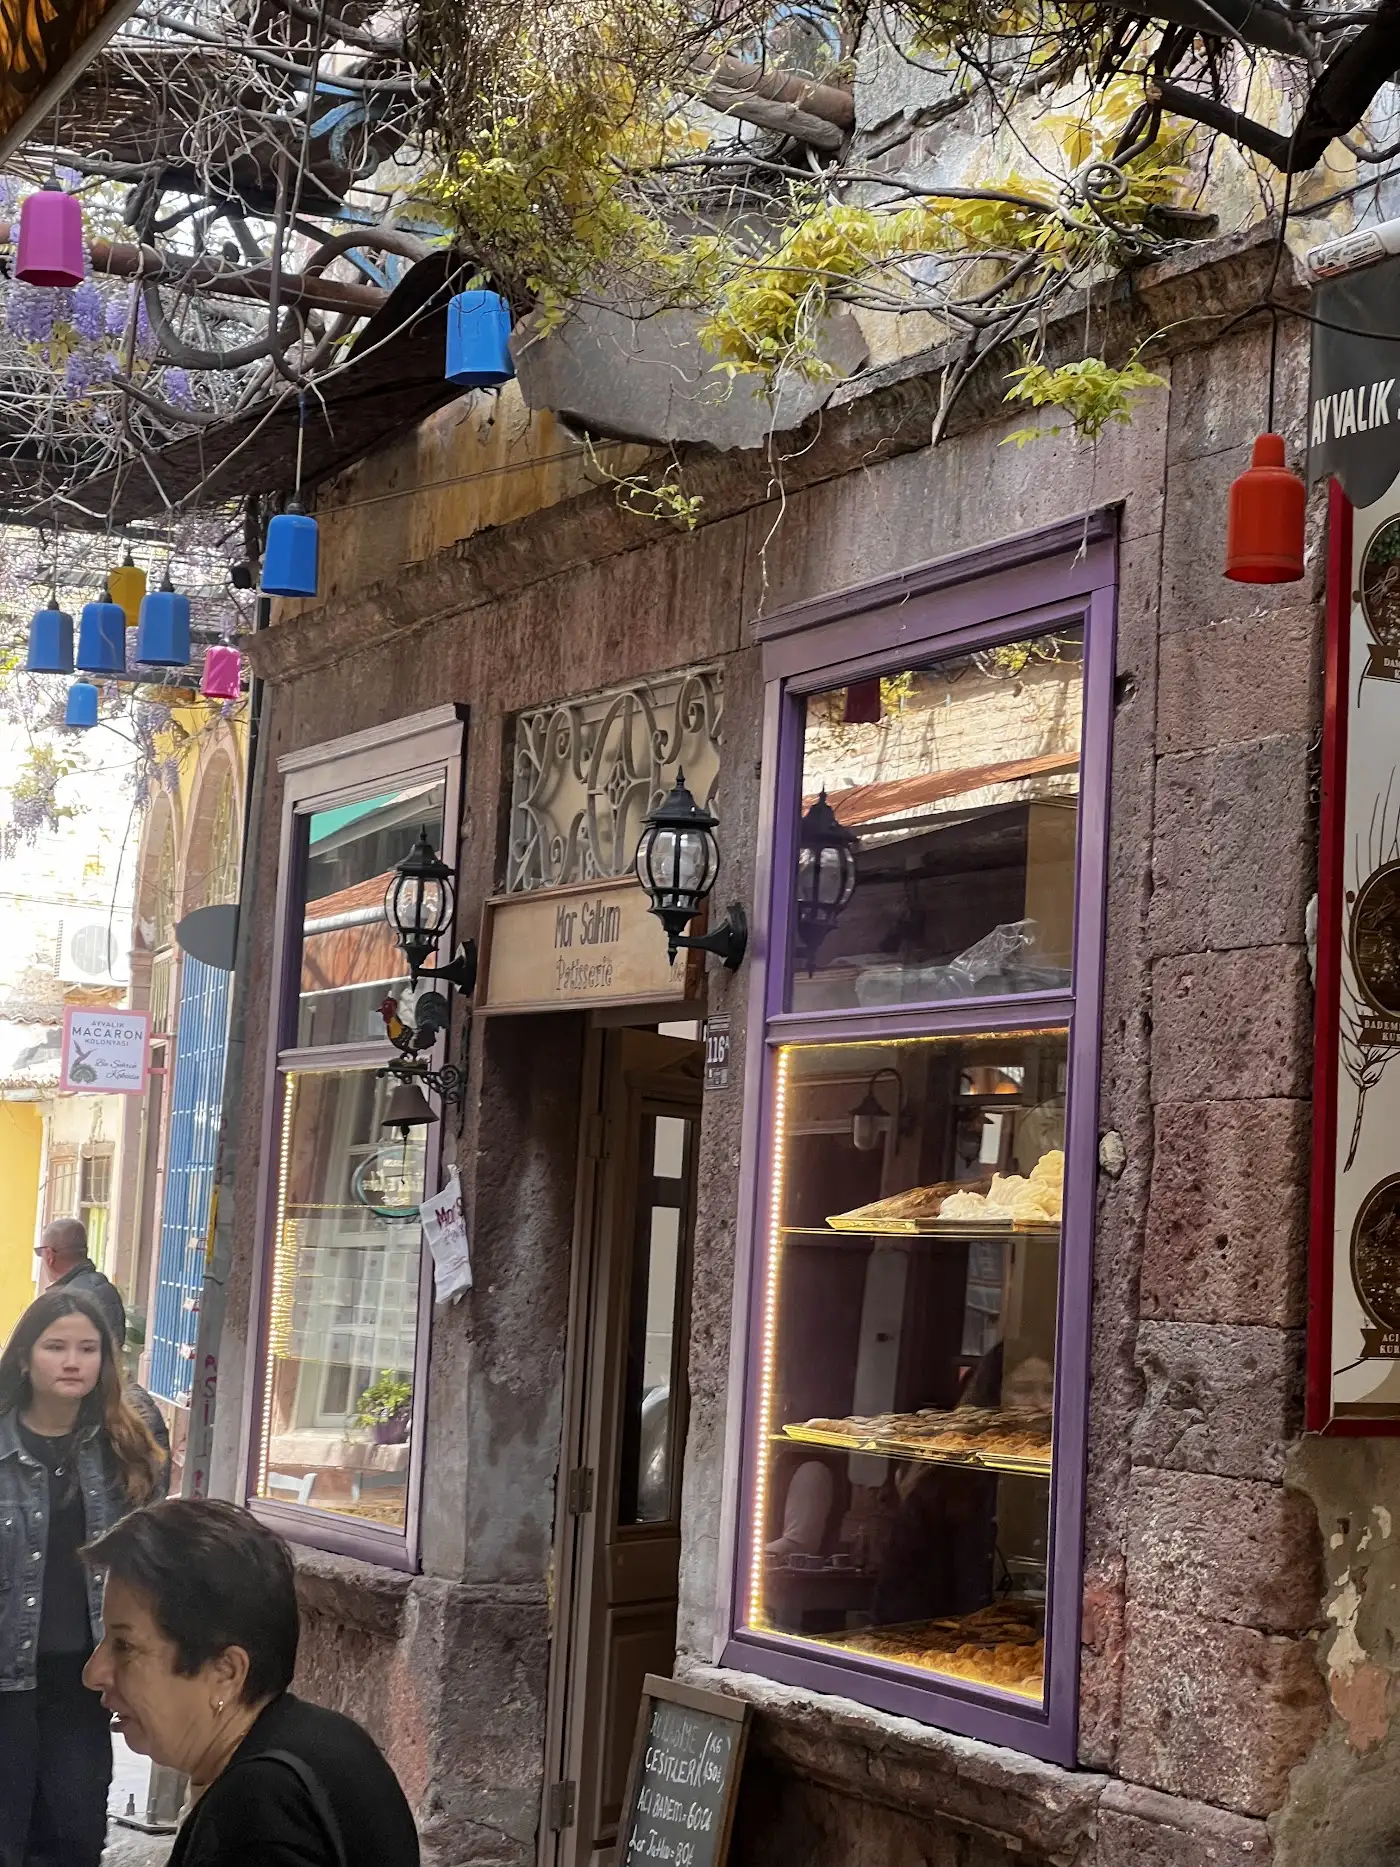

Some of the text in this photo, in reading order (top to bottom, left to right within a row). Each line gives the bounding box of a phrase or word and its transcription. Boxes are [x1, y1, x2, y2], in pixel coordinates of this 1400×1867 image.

[1311, 378, 1396, 448] AYVALIK
[555, 905, 578, 948] Mor
[556, 955, 613, 990] Patisserie
[72, 1026, 143, 1040] MACARON
[91, 1020, 125, 1028] AYVALIK
[84, 1038, 129, 1047] KOLONYASI
